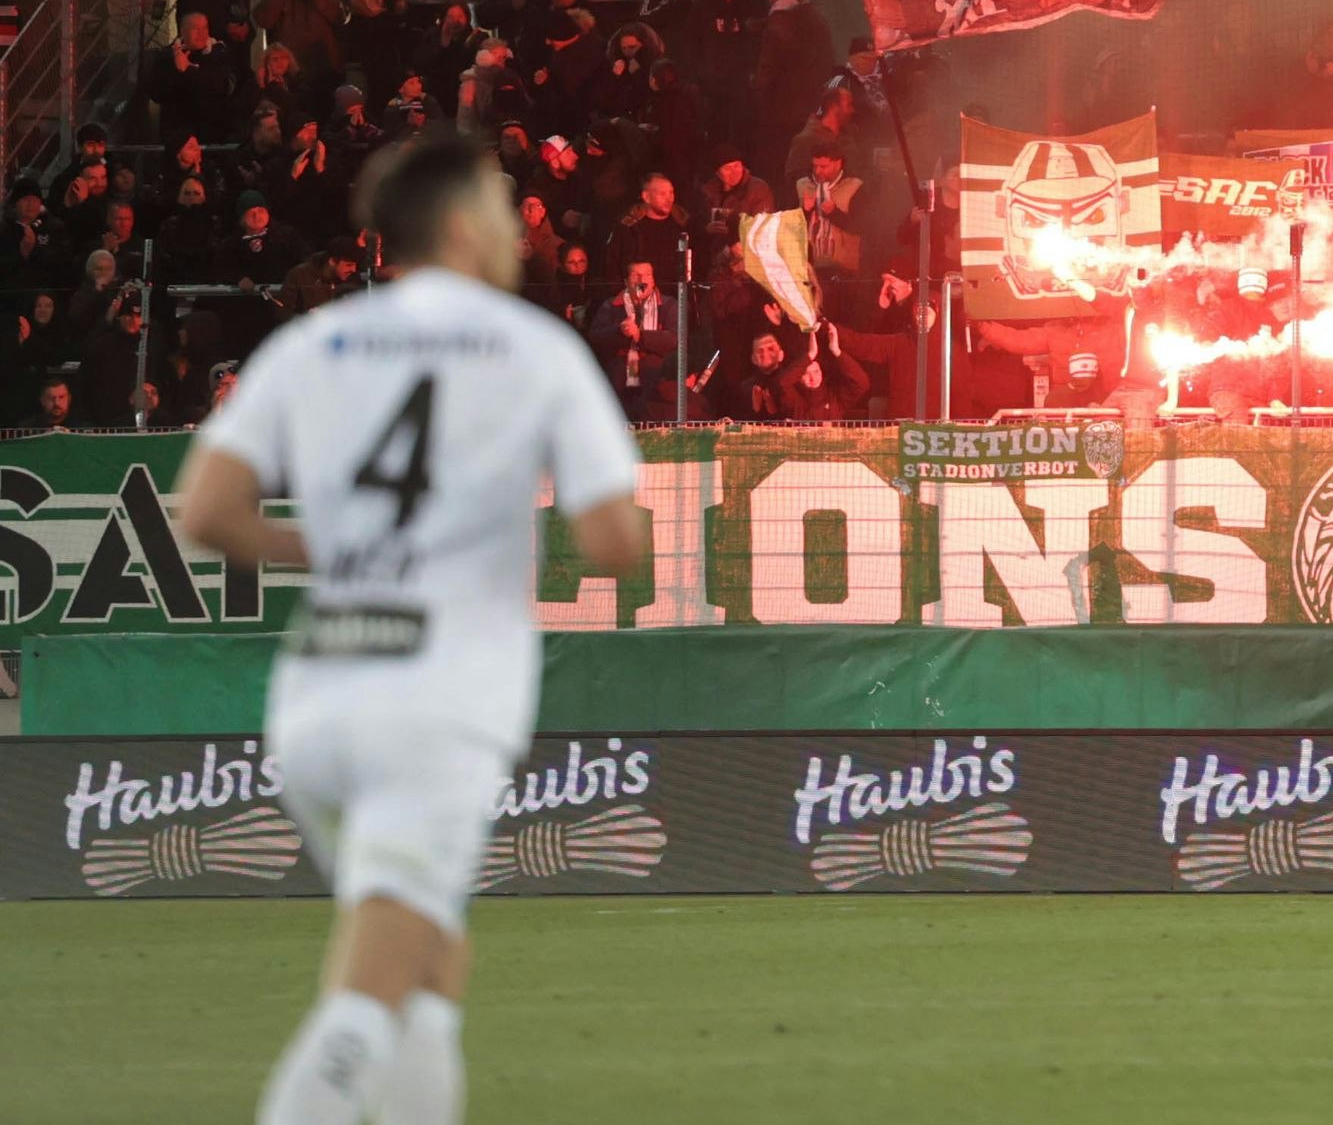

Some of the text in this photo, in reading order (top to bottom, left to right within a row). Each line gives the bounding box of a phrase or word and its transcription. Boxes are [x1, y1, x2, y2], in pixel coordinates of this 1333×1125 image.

[354, 373, 435, 529] 4
[903, 427, 1080, 458] SEKTION
[903, 460, 1079, 479] STADIONVERBOT
[64, 739, 285, 850] Haubis
[486, 737, 649, 820] aubis
[794, 735, 1015, 844] Haubis
